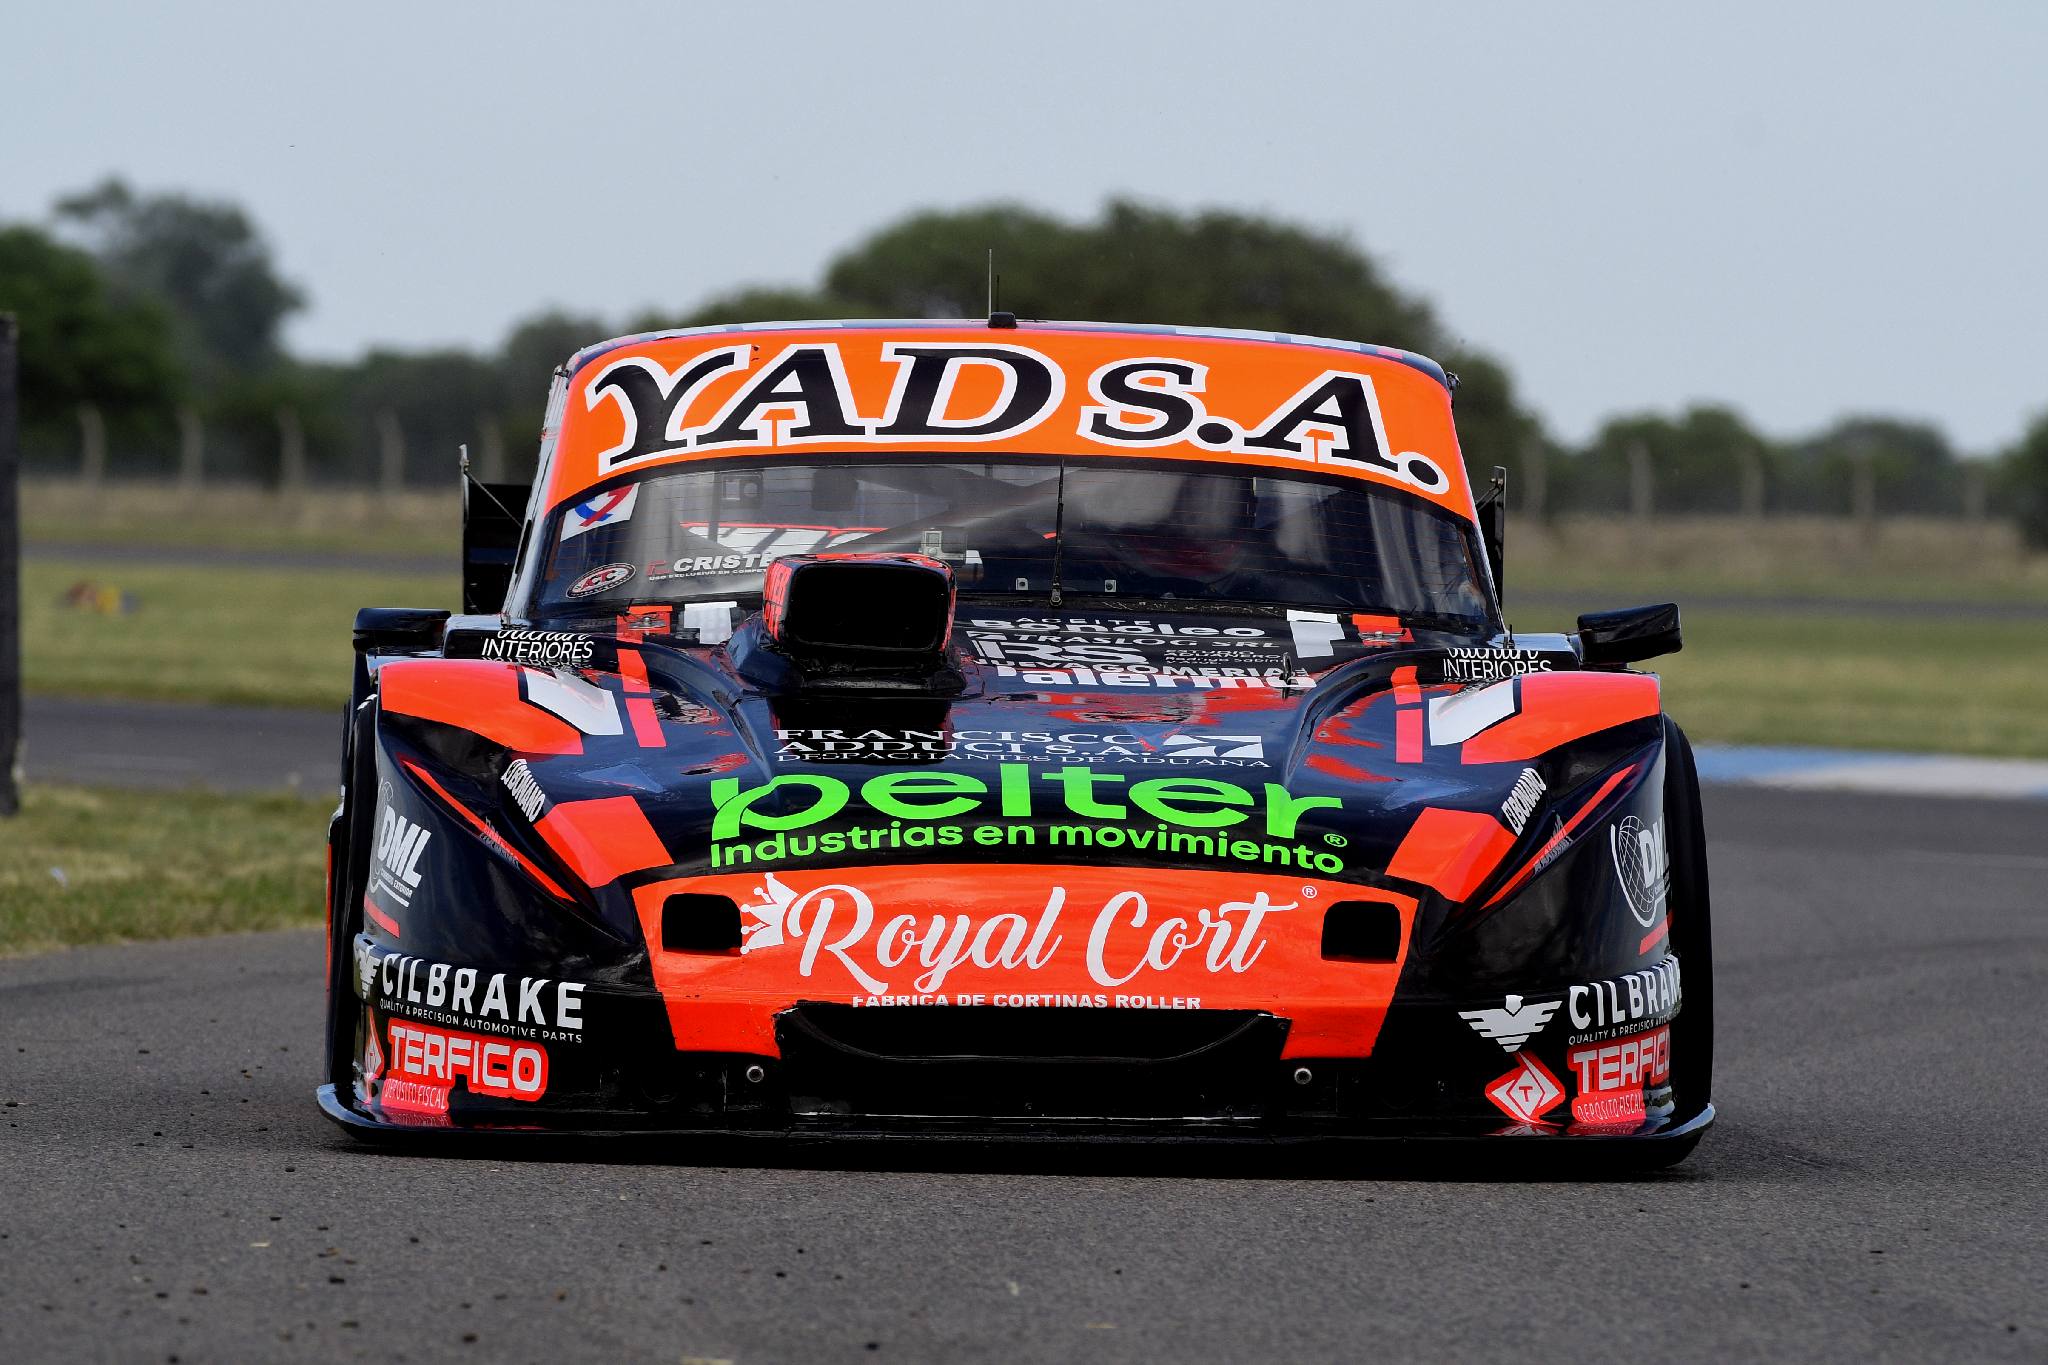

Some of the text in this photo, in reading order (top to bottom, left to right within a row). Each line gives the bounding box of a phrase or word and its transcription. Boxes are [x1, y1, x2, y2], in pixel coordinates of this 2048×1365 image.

[1015, 617, 1152, 626] ACEITE
[481, 638, 595, 659] INTERIORES
[1014, 633, 1198, 647] TRASLOG
[1443, 658, 1553, 679] INTERIORES
[772, 729, 1142, 745] FRANCISCO
[774, 741, 1152, 756] ADDUCI S.A.
[778, 752, 1052, 762] DESPACHANTES
[1117, 757, 1273, 768] ADUANA
[711, 764, 1343, 840] pelter
[377, 805, 432, 888] DML
[710, 825, 1344, 874] Industrias en movimiento
[787, 885, 1066, 995] Royal
[1086, 890, 1299, 987] Cort
[382, 953, 587, 1030] CILBRAKE
[957, 994, 986, 1006] DE
[993, 994, 1108, 1008] CORTINAS
[1115, 994, 1201, 1010] ROLLER
[379, 998, 404, 1015] QUALITY
[412, 1006, 459, 1026] PRECISION
[463, 1017, 536, 1038] AUTOMOTIVE
[542, 1030, 582, 1044] PARTS
[1568, 1030, 1609, 1046] QUALITY
[390, 1026, 542, 1092] TERFICO
